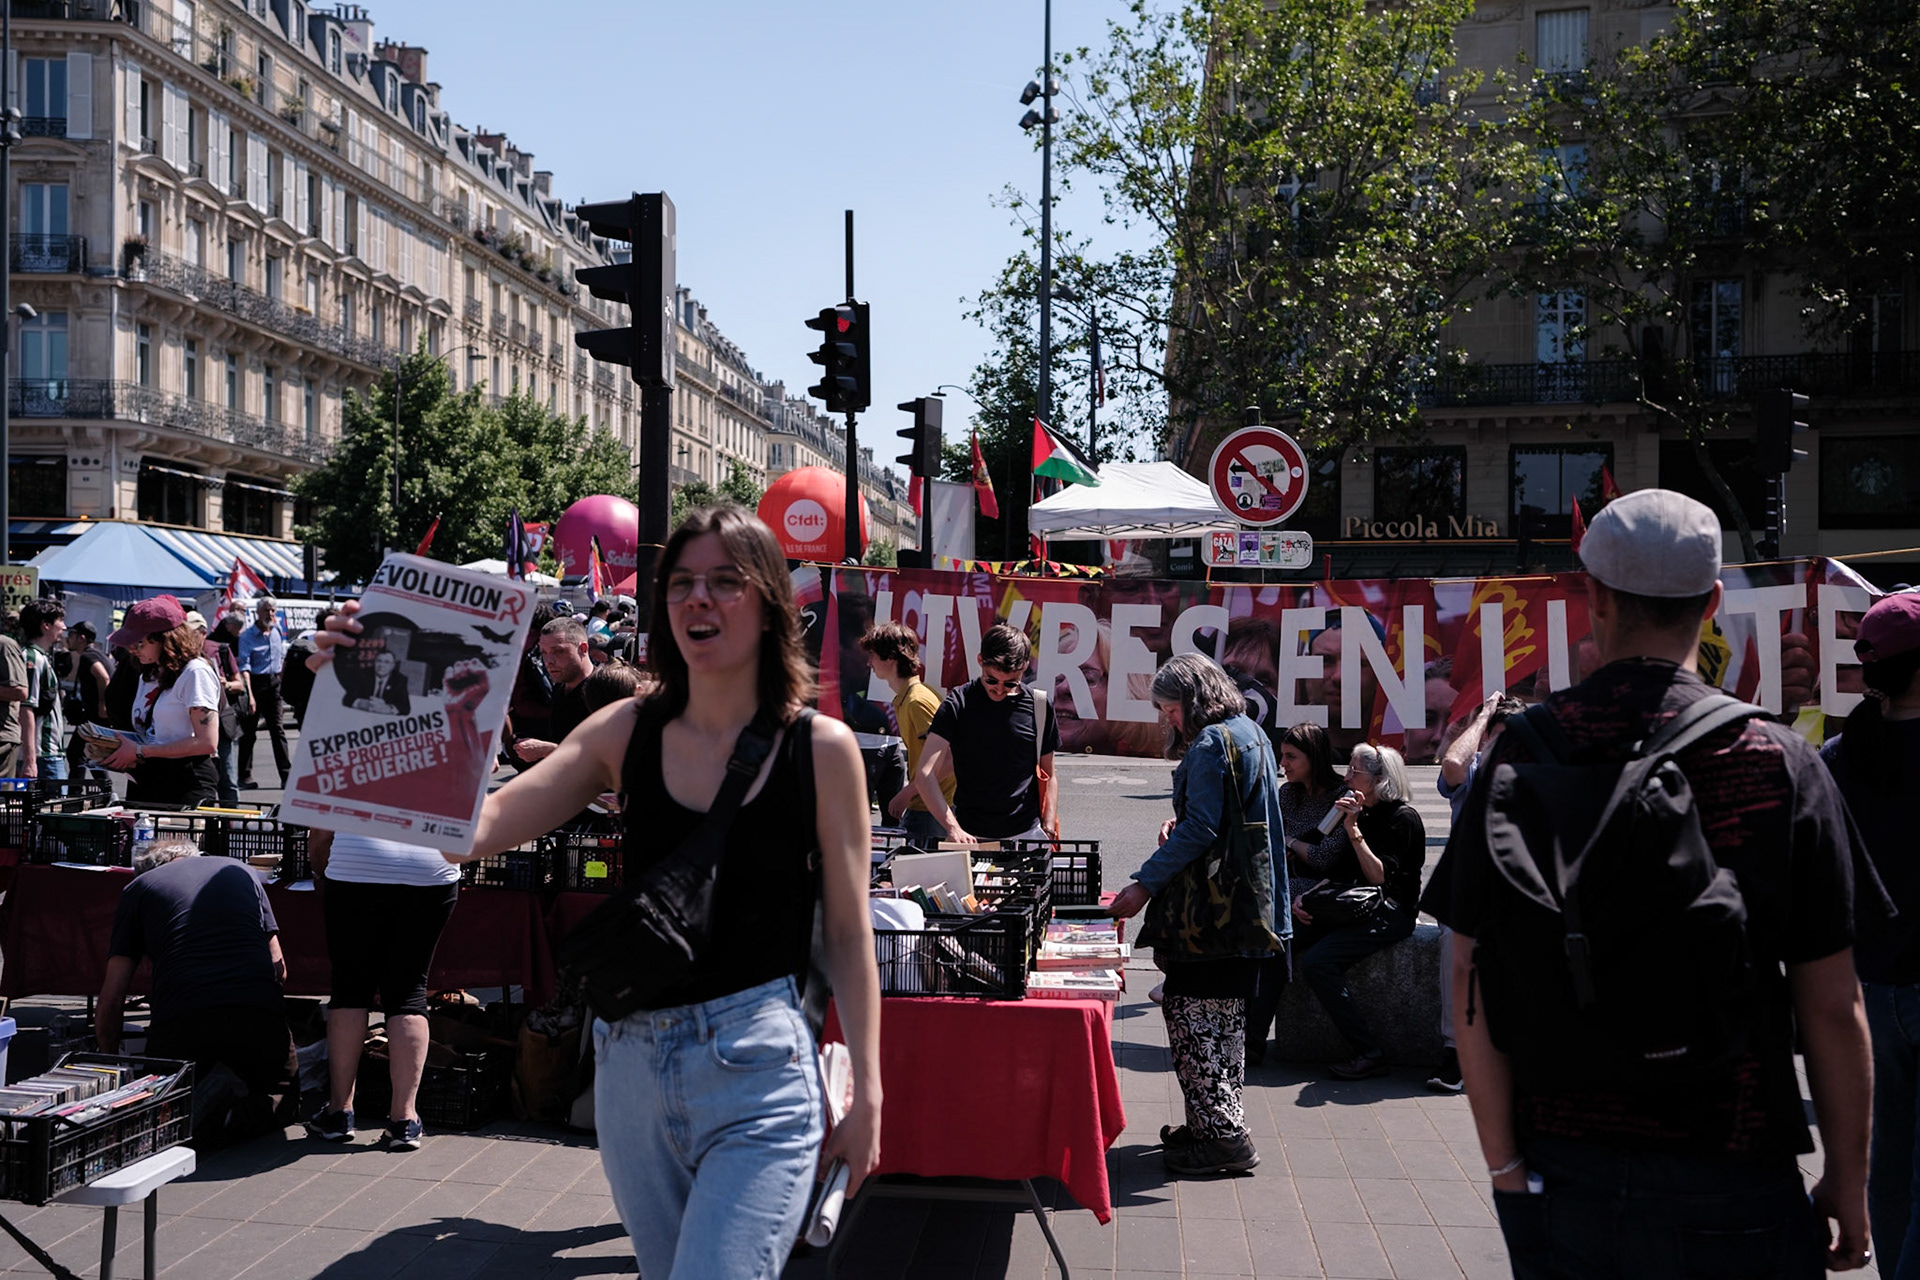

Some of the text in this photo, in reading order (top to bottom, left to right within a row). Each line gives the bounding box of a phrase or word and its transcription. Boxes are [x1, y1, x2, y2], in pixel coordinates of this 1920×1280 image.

[787, 514, 824, 526] Cfdt:
[1344, 513, 1499, 538] Piccola Mia
[795, 543, 804, 553] DE
[803, 543, 828, 553] FRANCE
[1213, 537, 1234, 547] GAZA
[1275, 604, 1426, 729] EN
[309, 711, 444, 758] EXPROPRIONS
[313, 729, 446, 774] LES PROFITEURS
[316, 743, 449, 795] DE GUERRE !
[421, 821, 437, 834] 3€
